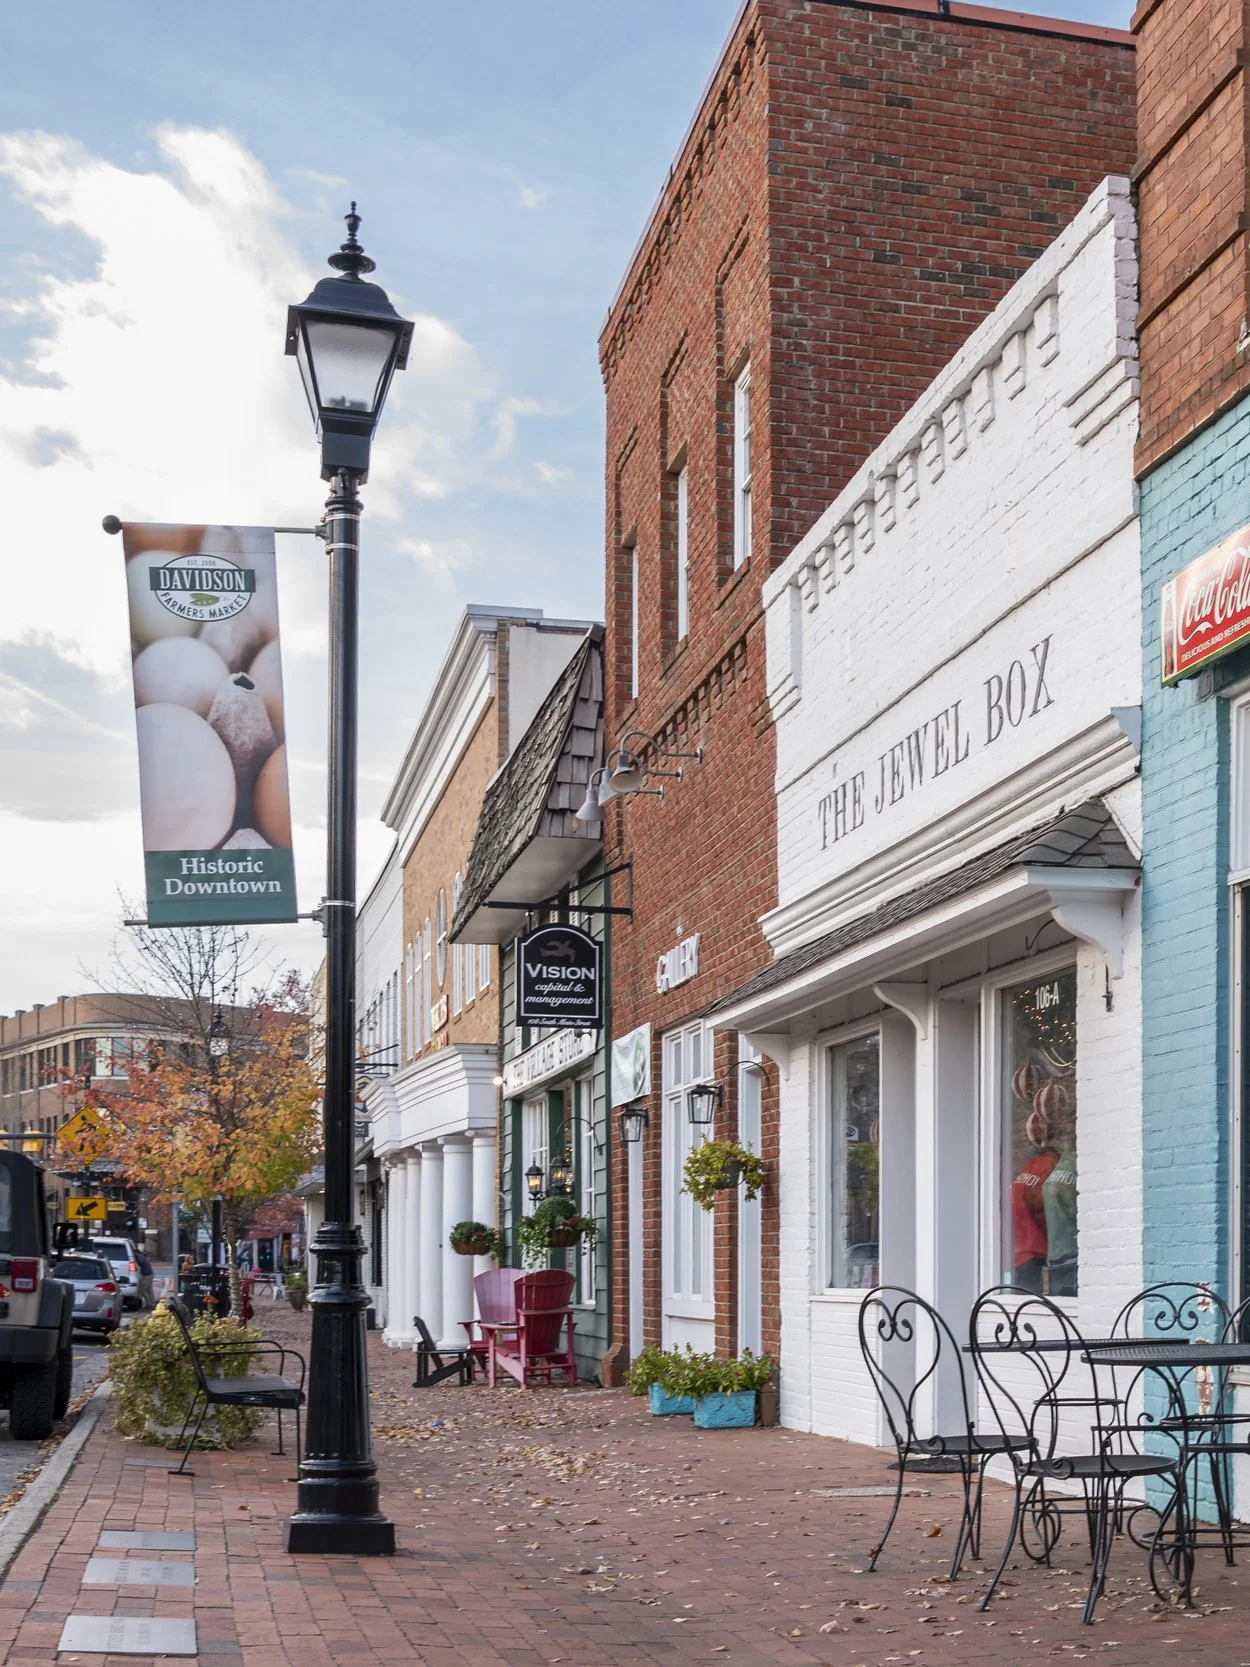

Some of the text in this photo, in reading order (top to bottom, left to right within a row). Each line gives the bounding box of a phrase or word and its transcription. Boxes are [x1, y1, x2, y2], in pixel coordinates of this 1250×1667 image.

[159, 569, 245, 591] DAVIDSON
[161, 592, 247, 619] FARMERS MARKET
[1181, 639, 1212, 662] DELICIOUS
[1210, 631, 1225, 648] AND
[819, 633, 1055, 851] THE JEWEL BOX
[180, 857, 264, 877] Historic
[164, 876, 282, 896] Downtown
[525, 963, 595, 980] VISION
[534, 981, 586, 995] capital &
[1034, 981, 1060, 1011] 106-A
[524, 994, 594, 1008] management
